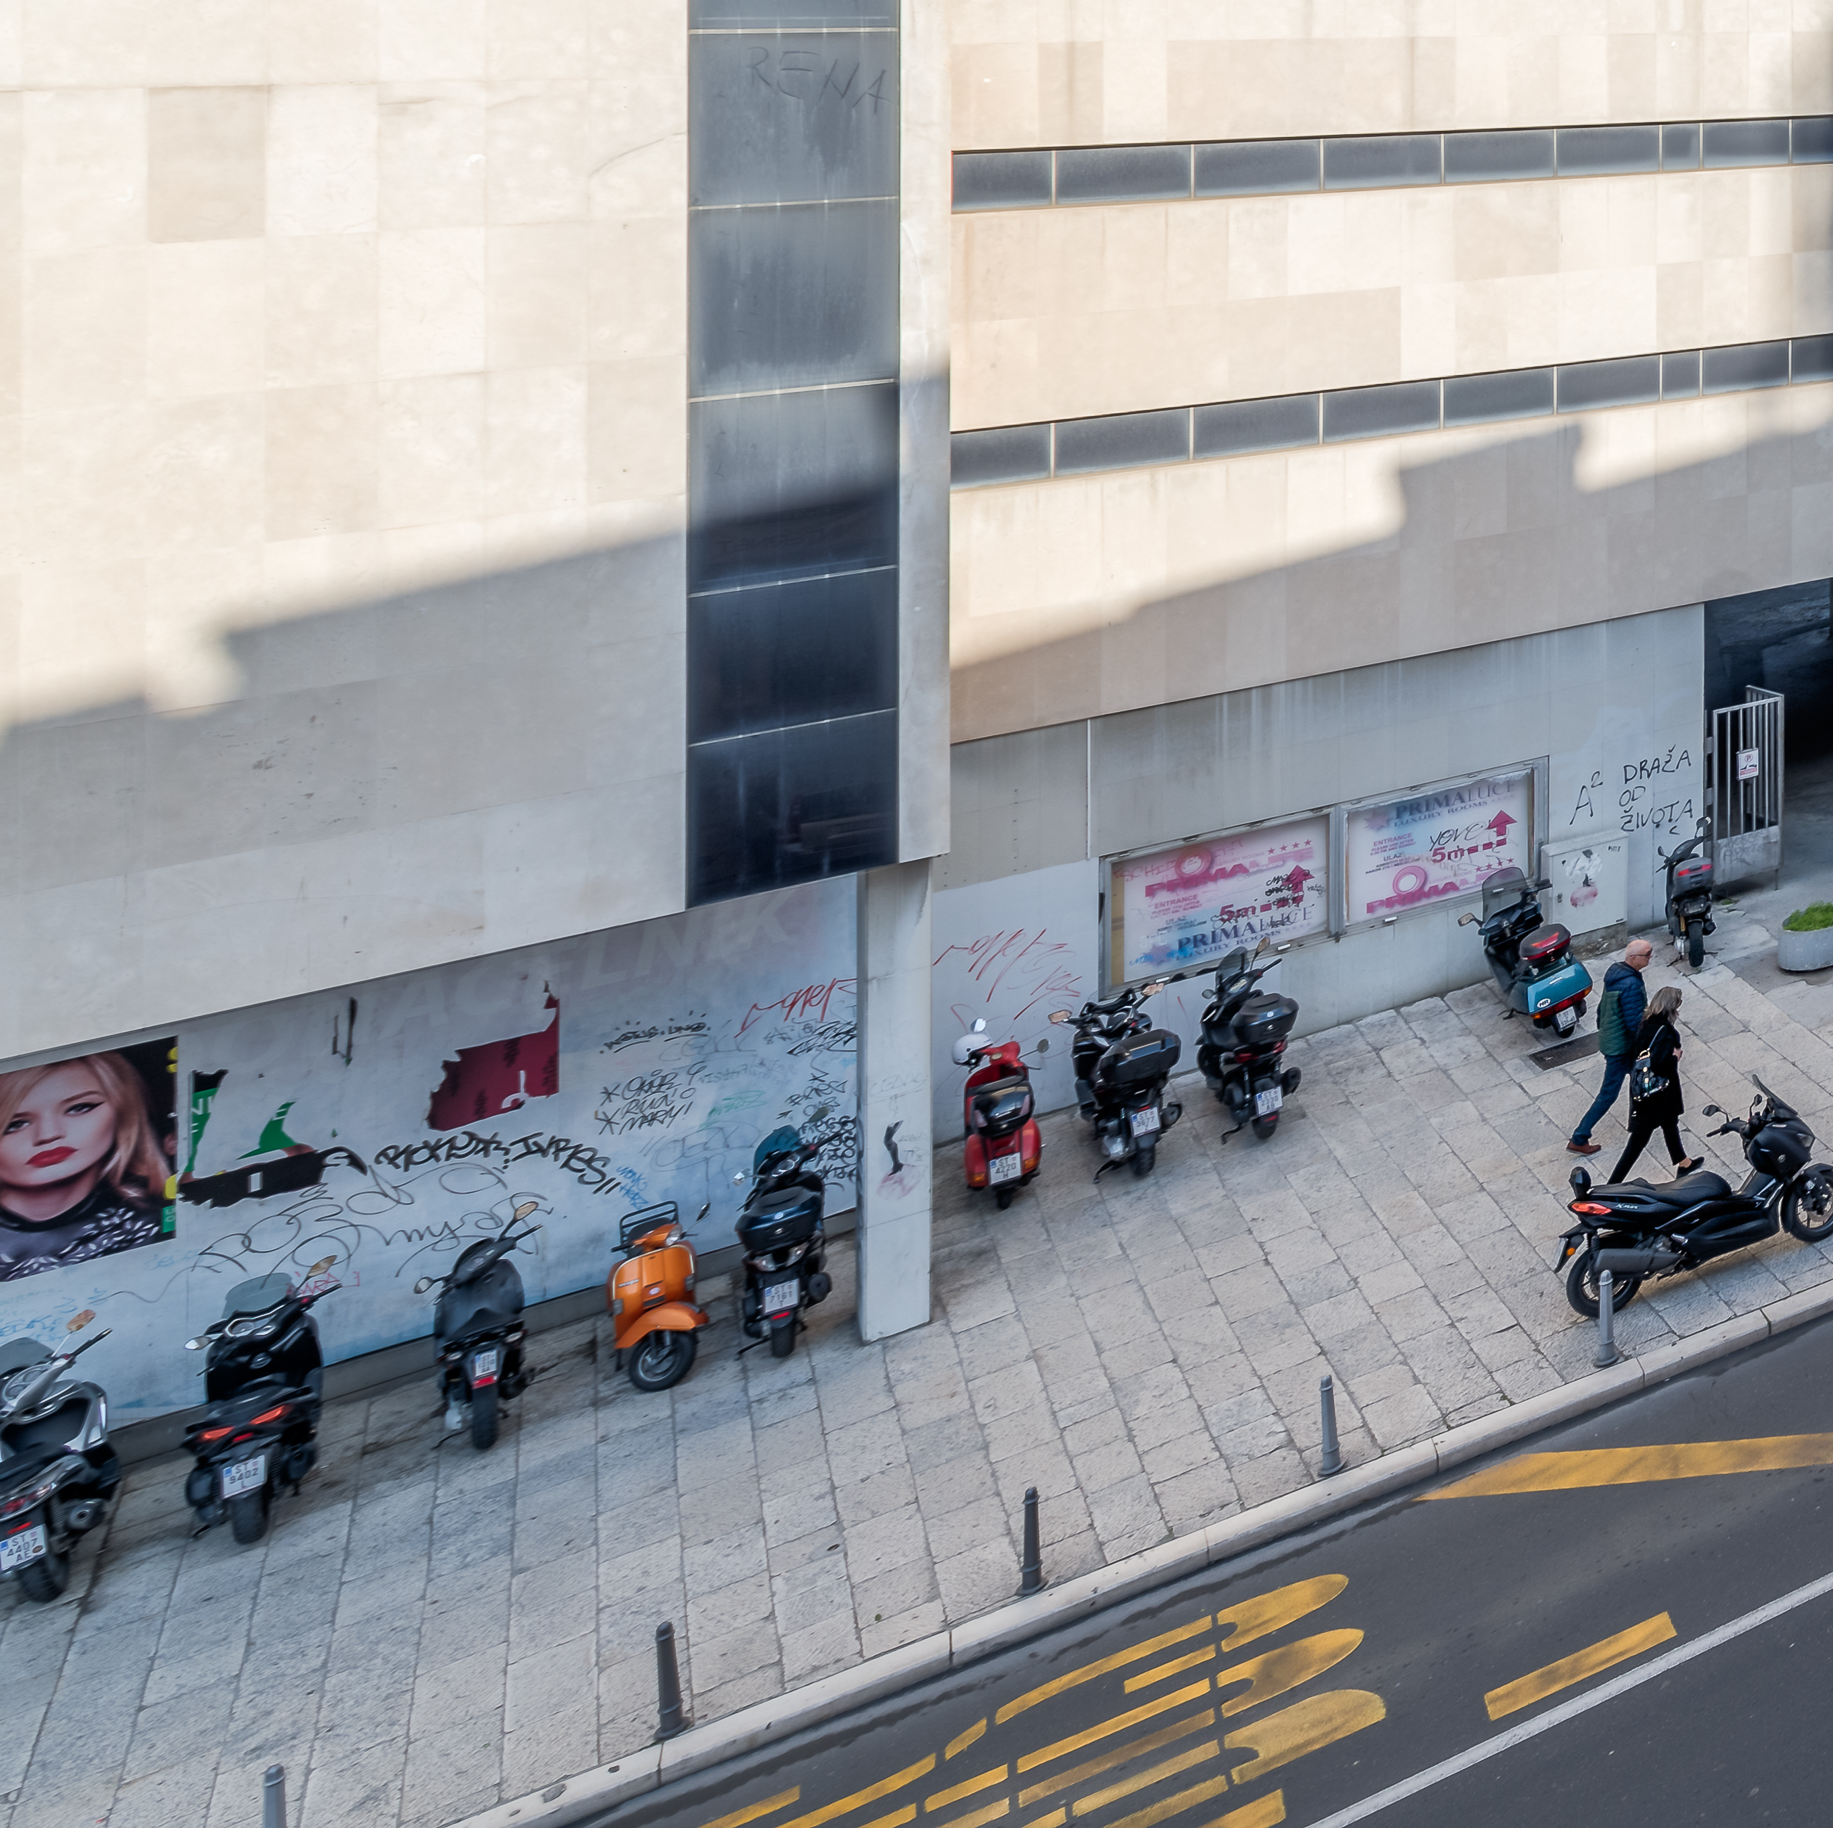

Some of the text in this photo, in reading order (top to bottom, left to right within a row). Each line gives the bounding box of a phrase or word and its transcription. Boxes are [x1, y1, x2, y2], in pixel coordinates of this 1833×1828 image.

[1623, 744, 1692, 785] DRAŽA
[1396, 780, 1515, 819] PRIMALUCE
[1618, 786, 1646, 807] OD
[1394, 801, 1488, 827] LUXURY ROOMS
[1620, 799, 1693, 832] ŽIVOTA
[1373, 832, 1413, 847] ENTRANCE
[1432, 846, 1464, 863] 5m
[1154, 894, 1199, 910] ENTRANCE
[1176, 929, 1281, 962] LUXURY ROOMS
[995, 1162, 1017, 1174] 4220
[998, 1157, 1010, 1167] ST
[774, 1285, 786, 1295] ST
[229, 1467, 259, 1485] 9402
[235, 1462, 249, 1474] ST
[241, 1480, 247, 1489] L
[7, 1538, 38, 1557] 4407
[12, 1533, 27, 1547] ST
[16, 1550, 31, 1562] AE
